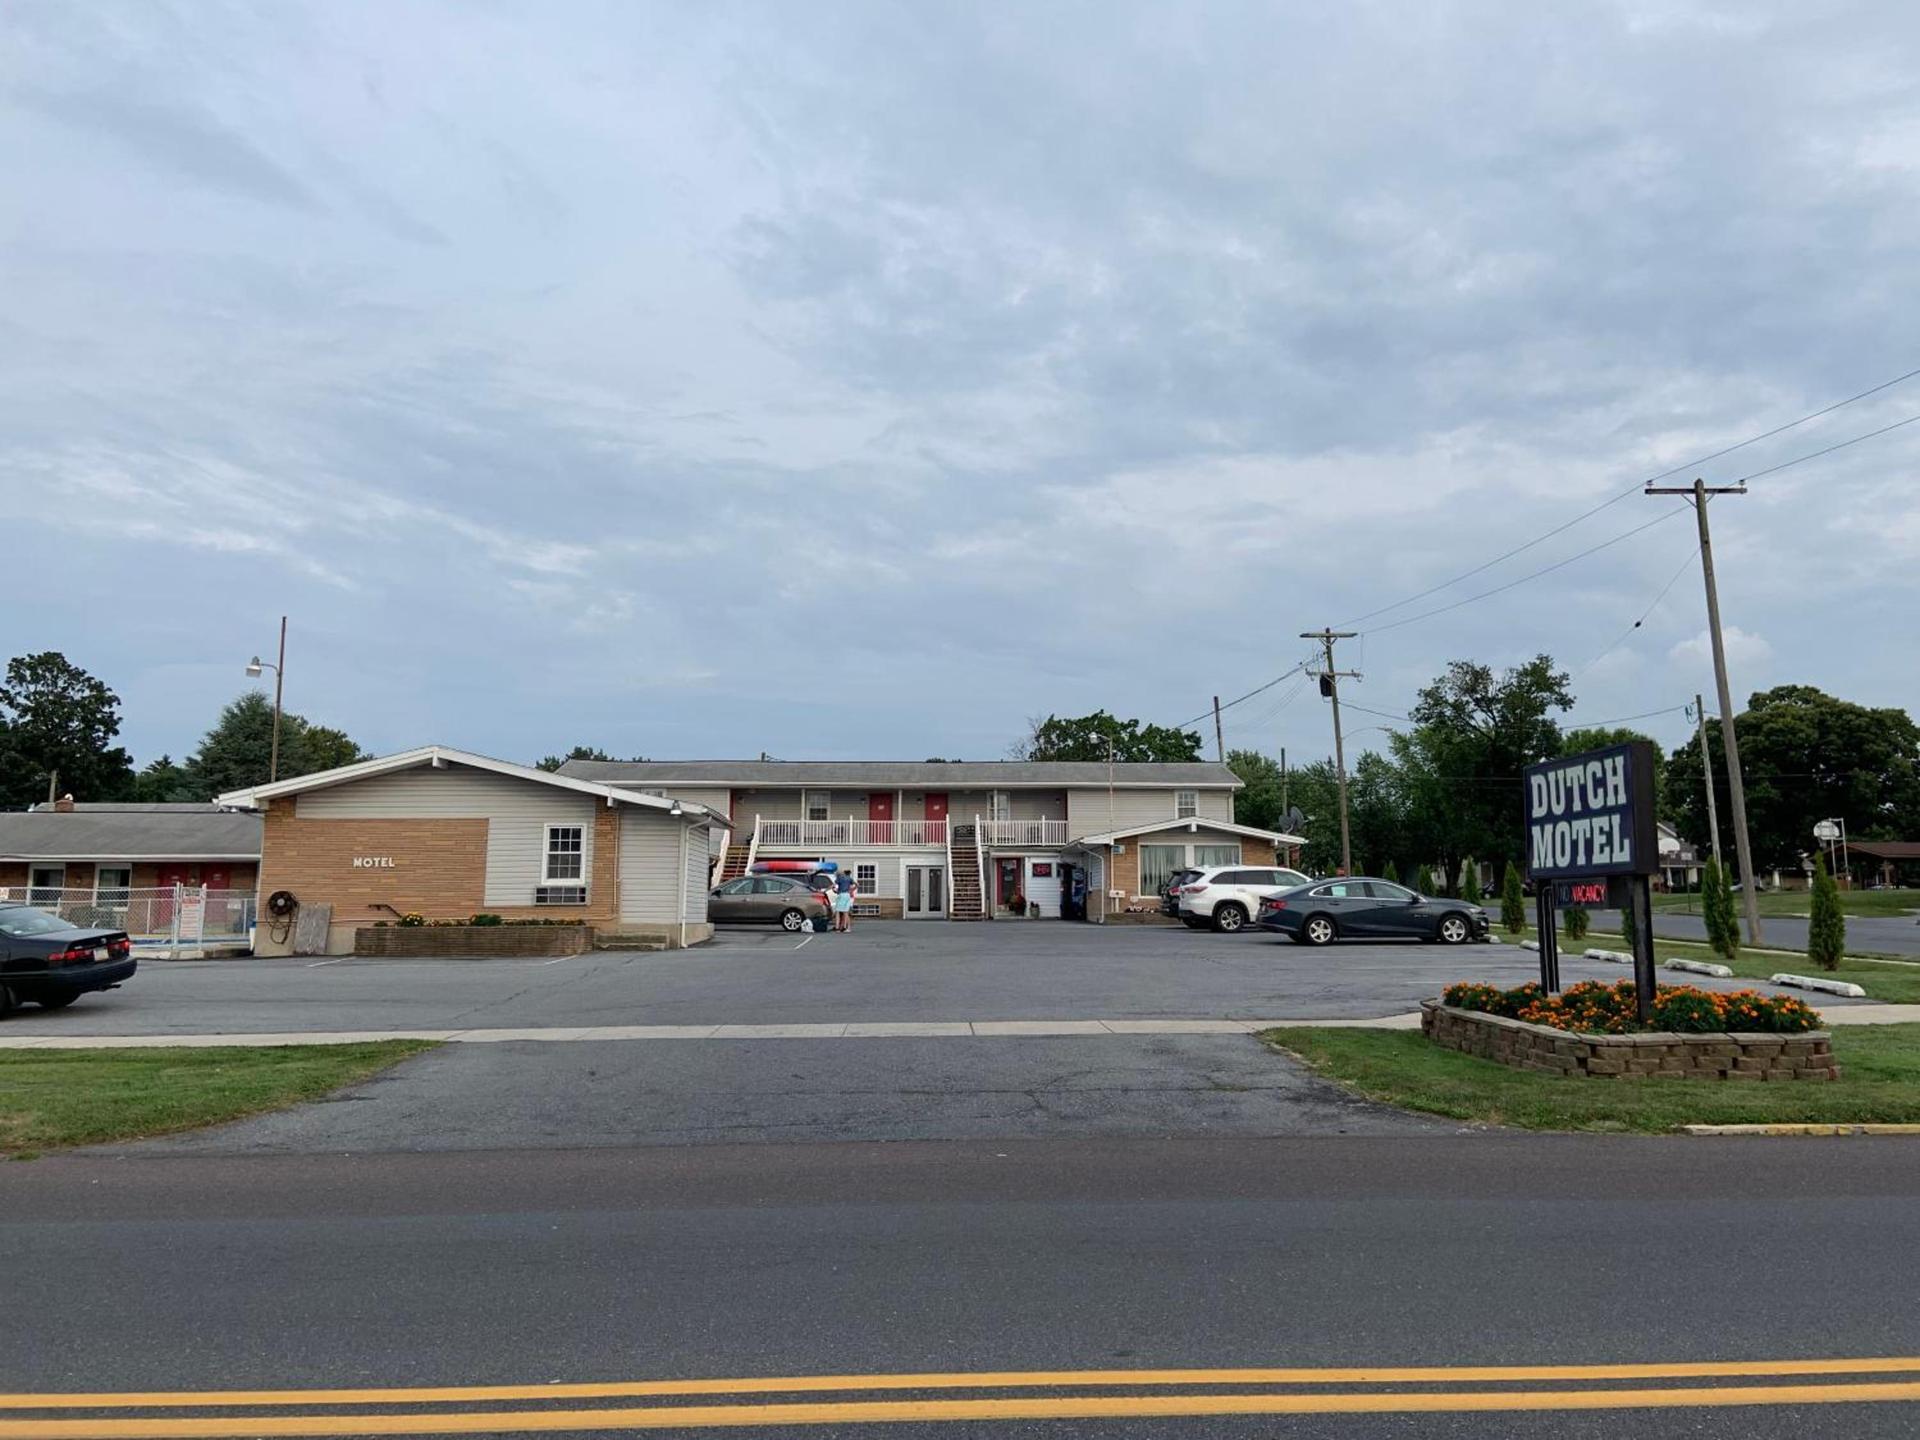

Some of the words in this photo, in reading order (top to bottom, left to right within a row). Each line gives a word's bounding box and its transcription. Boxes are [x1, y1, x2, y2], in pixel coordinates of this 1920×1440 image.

[1531, 756, 1627, 818] DUTCH
[1531, 814, 1630, 869] MOTEL
[353, 857, 394, 867] MOTEL
[1572, 885, 1606, 902] VACANCY
